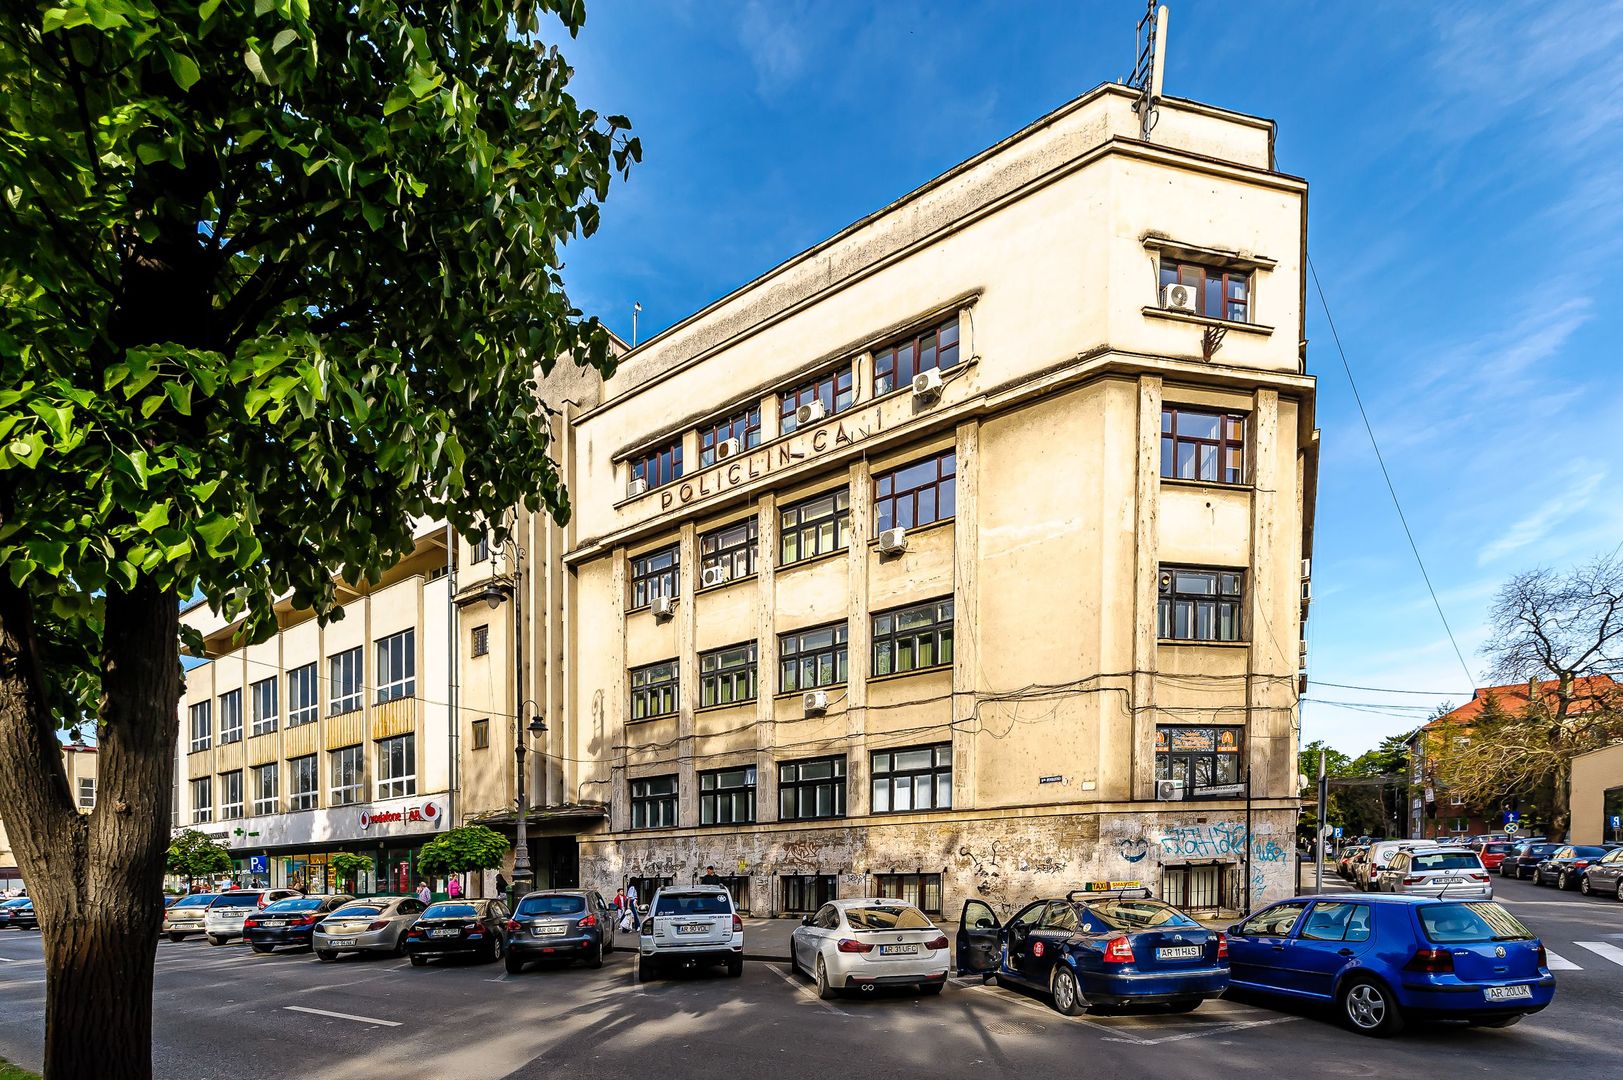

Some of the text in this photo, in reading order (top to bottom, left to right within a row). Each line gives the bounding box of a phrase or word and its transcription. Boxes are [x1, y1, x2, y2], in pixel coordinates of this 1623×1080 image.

[250, 857, 259, 870] P
[1092, 882, 1107, 890] TAXI
[1161, 949, 1173, 957] AR
[1181, 947, 1197, 956] HAS
[1491, 988, 1503, 998] AR
